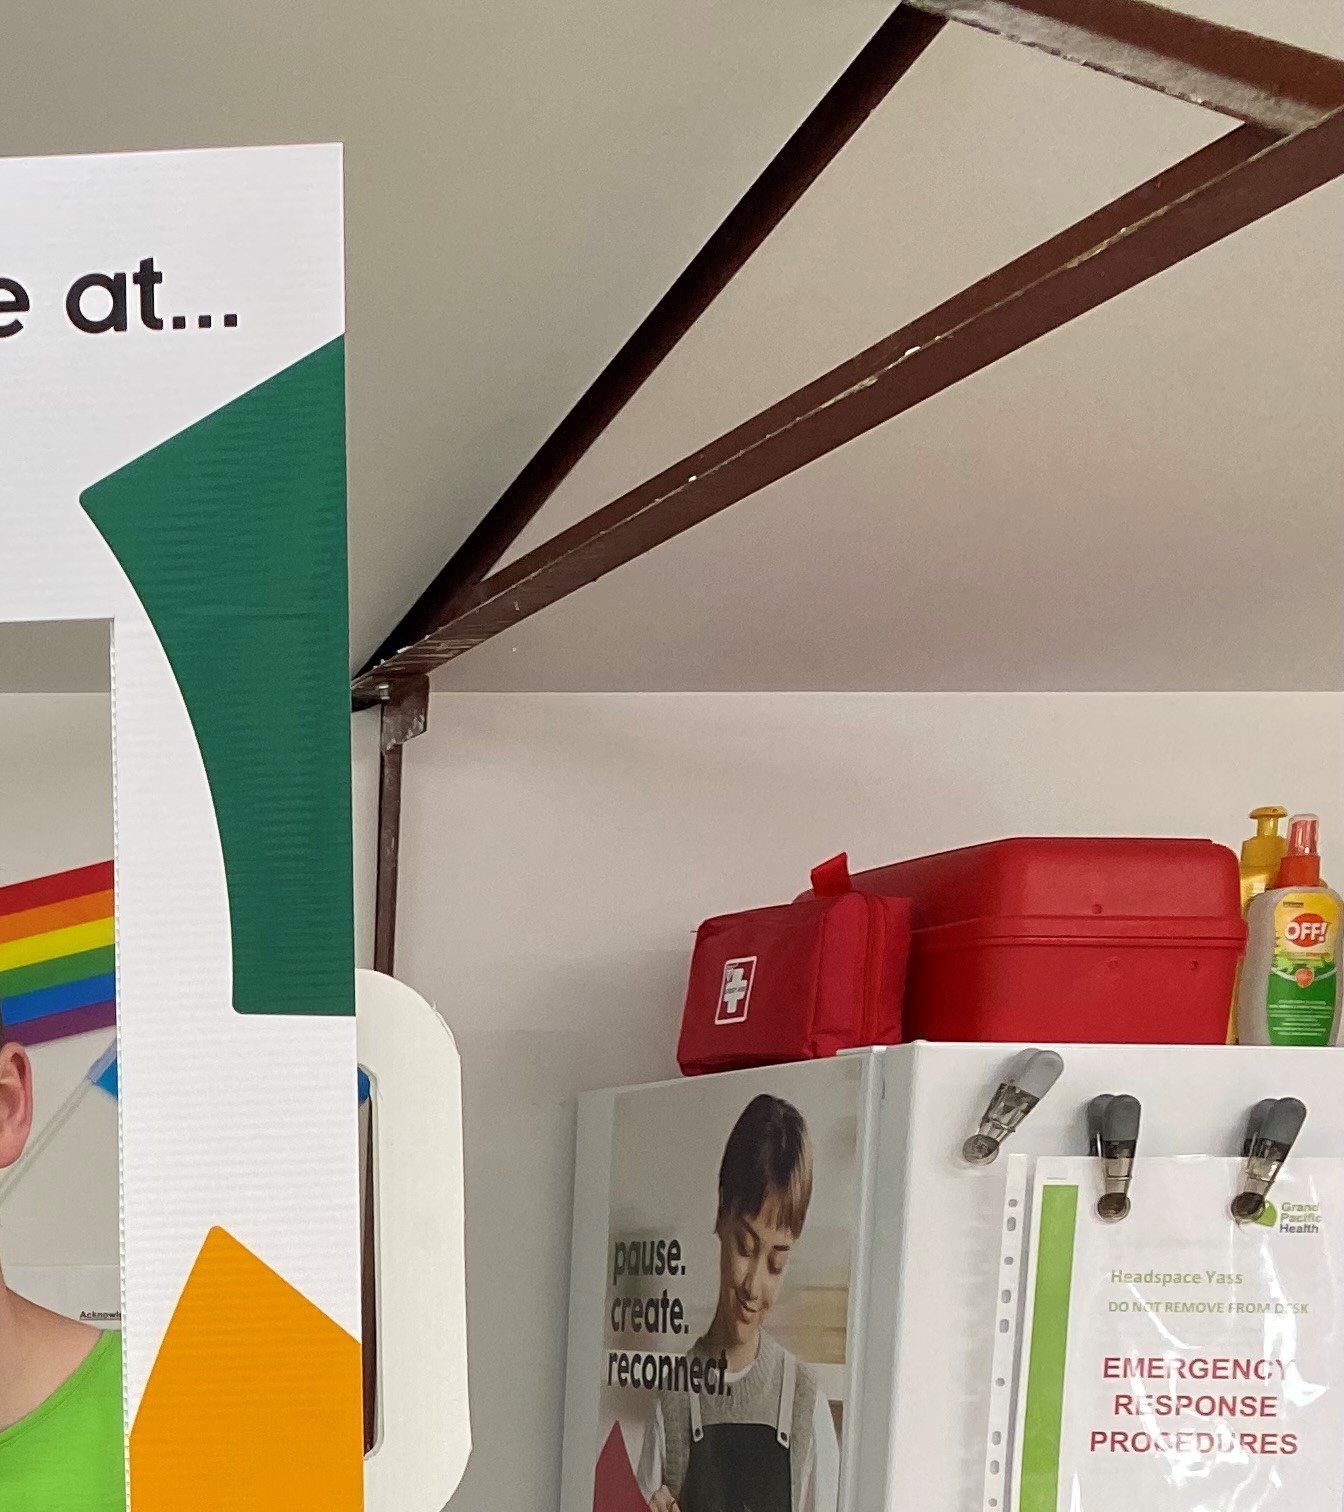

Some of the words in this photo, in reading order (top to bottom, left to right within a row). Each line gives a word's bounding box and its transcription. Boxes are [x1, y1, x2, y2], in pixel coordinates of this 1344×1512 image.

[65, 257, 238, 333] at...
[1285, 922, 1327, 941] OFF!
[1282, 1202, 1320, 1211] Grand
[1281, 1213, 1322, 1222] Pacific
[1280, 1224, 1318, 1233] Health
[614, 1240, 686, 1285] pause.
[1111, 1270, 1201, 1286] Headspace
[1206, 1271, 1243, 1284] Yass
[612, 1289, 688, 1334] create.
[1109, 1302, 1128, 1312] DO
[1133, 1302, 1161, 1312] NOT
[1165, 1302, 1224, 1312] REMOVE
[1229, 1303, 1270, 1313] FROM
[1275, 1303, 1308, 1314] DSK
[608, 1349, 731, 1396] reconnect.
[1104, 1358, 1292, 1380] EMERGENCY
[1114, 1395, 1277, 1417] RESPONSE
